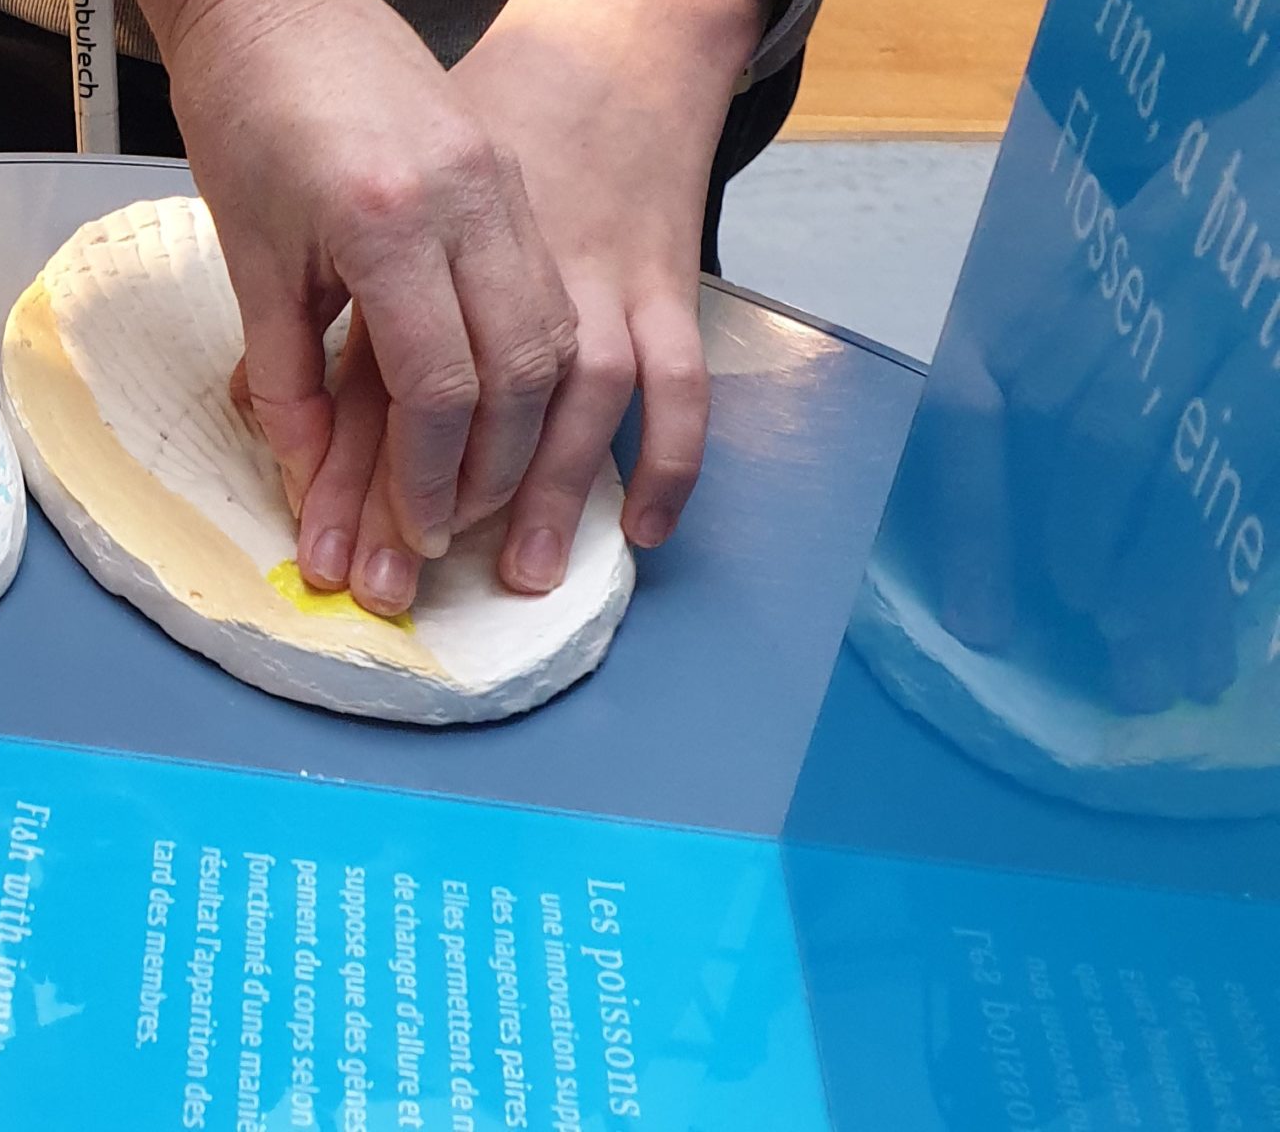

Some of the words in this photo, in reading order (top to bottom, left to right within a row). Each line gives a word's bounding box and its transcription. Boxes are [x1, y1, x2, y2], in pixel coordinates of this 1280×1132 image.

[1173, 118, 1209, 196] a
[1052, 87, 1165, 416] Flossen,
[1174, 397, 1265, 595] eine
[8, 800, 50, 861] Fish
[151, 839, 177, 885] tard
[147, 888, 175, 927] des
[197, 846, 228, 933] résultat
[242, 852, 276, 976] fonctionné
[291, 858, 319, 947] pement
[339, 866, 366, 958] suppose
[393, 872, 420, 901] de
[442, 880, 470, 930] Elles
[491, 886, 517, 925] des
[540, 893, 563, 935] une
[586, 877, 625, 935] Les
[294, 949, 322, 980] du
[339, 961, 366, 1008] que
[389, 904, 421, 999] changer
[488, 928, 526, 1045] nageoires
[135, 931, 167, 1049] membres.
[185, 936, 222, 1078] l'apparition
[240, 978, 270, 1048] d'une
[286, 983, 316, 1051] corps
[438, 932, 476, 1073] permettent
[546, 940, 580, 1072] innovation
[344, 1010, 373, 1054] des
[396, 1001, 425, 1095] d'allure
[580, 945, 640, 1118] poissons
[182, 1083, 213, 1130] des
[291, 1056, 320, 1126] selon
[337, 1057, 374, 1132] gènes
[398, 1099, 424, 1128] et
[451, 1077, 480, 1111] de
[494, 1048, 532, 1128] paires
